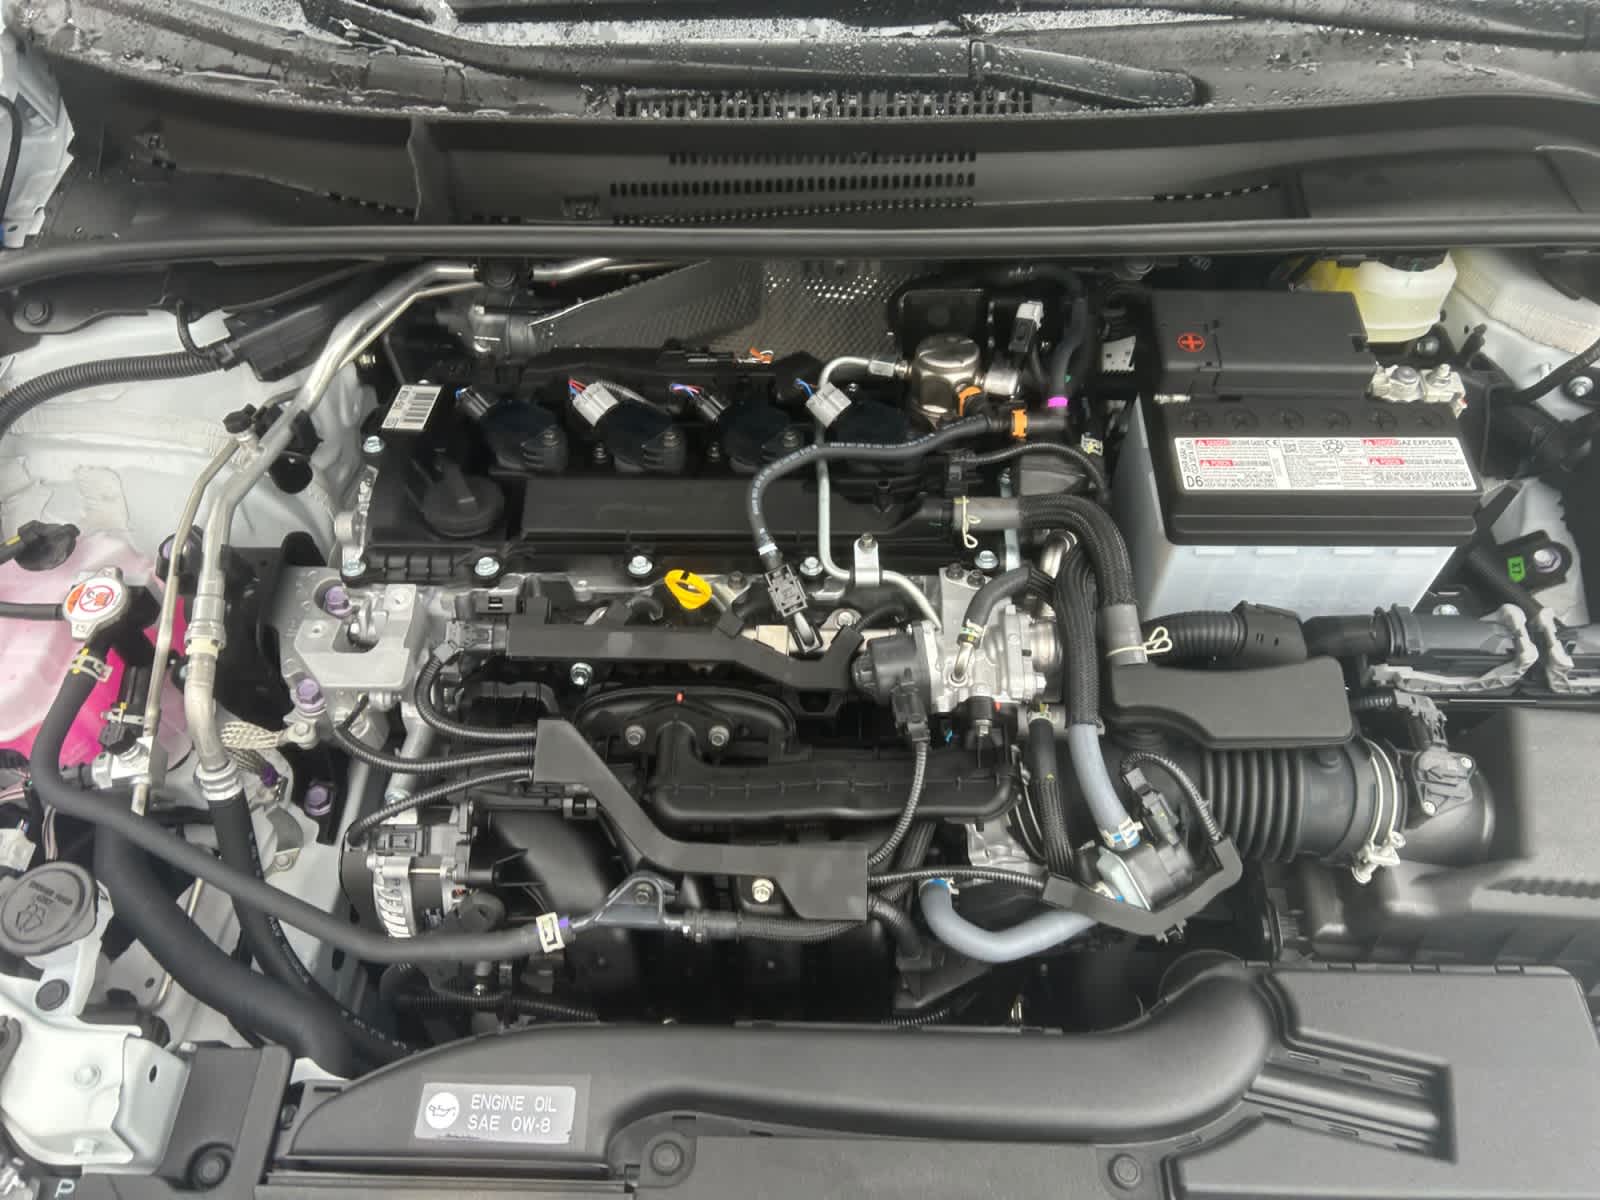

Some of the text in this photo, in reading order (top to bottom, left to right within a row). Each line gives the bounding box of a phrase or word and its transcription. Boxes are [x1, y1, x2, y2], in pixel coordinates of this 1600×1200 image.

[1186, 475, 1204, 488] D6
[471, 1093, 557, 1113] ENGINE OIL
[467, 1114, 501, 1131] SAE
[54, 1178, 75, 1198] P
